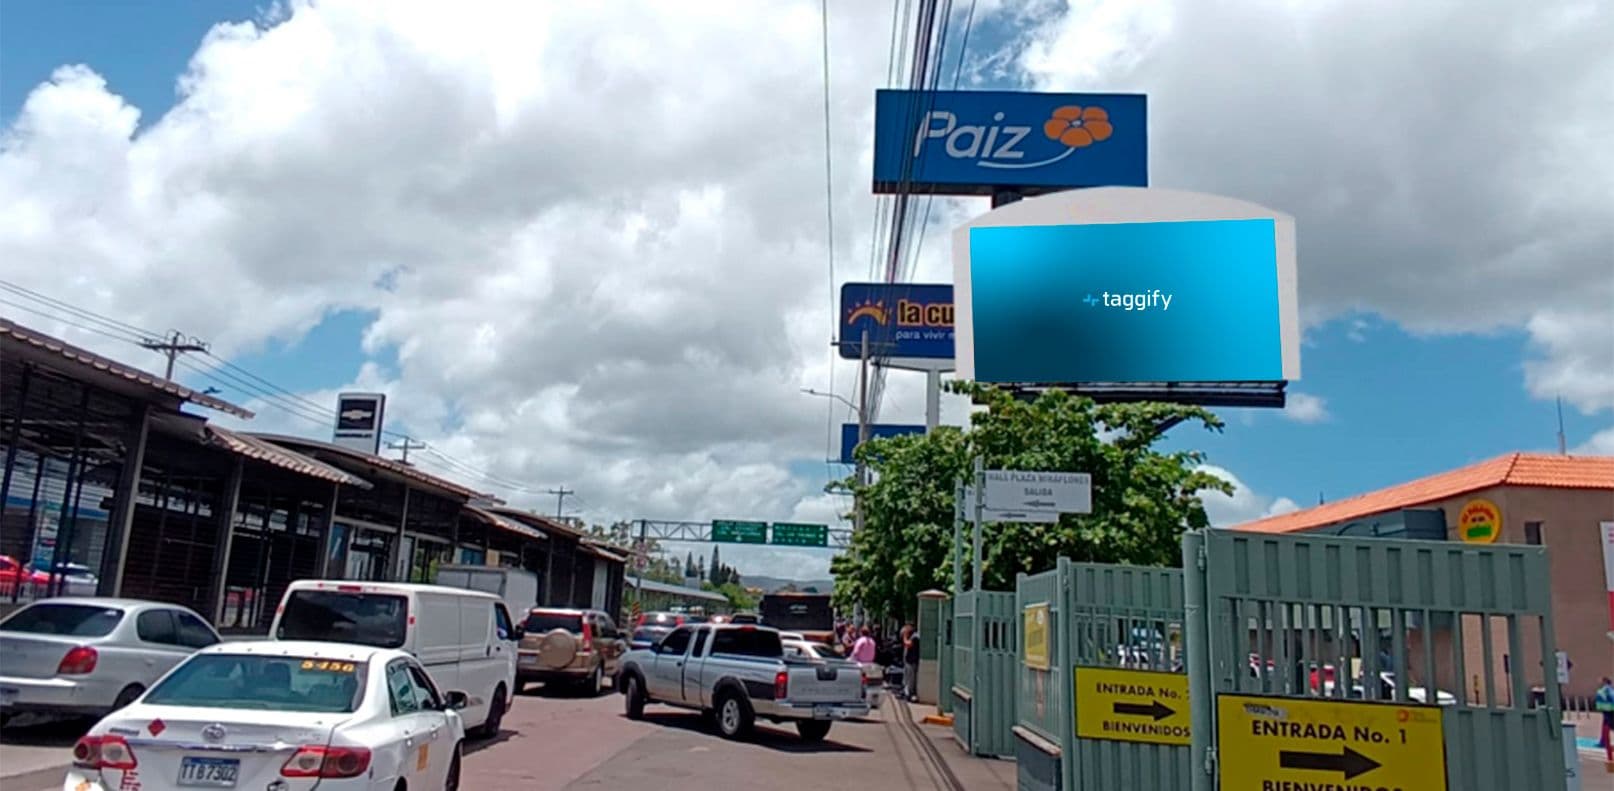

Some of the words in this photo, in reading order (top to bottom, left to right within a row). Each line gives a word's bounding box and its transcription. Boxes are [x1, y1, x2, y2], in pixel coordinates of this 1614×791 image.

[914, 110, 1032, 159] Paiz
[1102, 289, 1173, 311] taggify
[898, 299, 923, 327] la
[896, 330, 920, 340] para
[923, 329, 946, 340] vivir
[1024, 487, 1053, 496] SALIDA
[1096, 682, 1155, 697] ENTRADA
[1160, 687, 1182, 699] No.
[1103, 721, 1191, 738] BIENVENIDOS
[1252, 719, 1346, 741] ENTRADA
[1354, 726, 1390, 744] No.
[1399, 728, 1407, 744] 1
[1262, 780, 1404, 791] BIENVE
